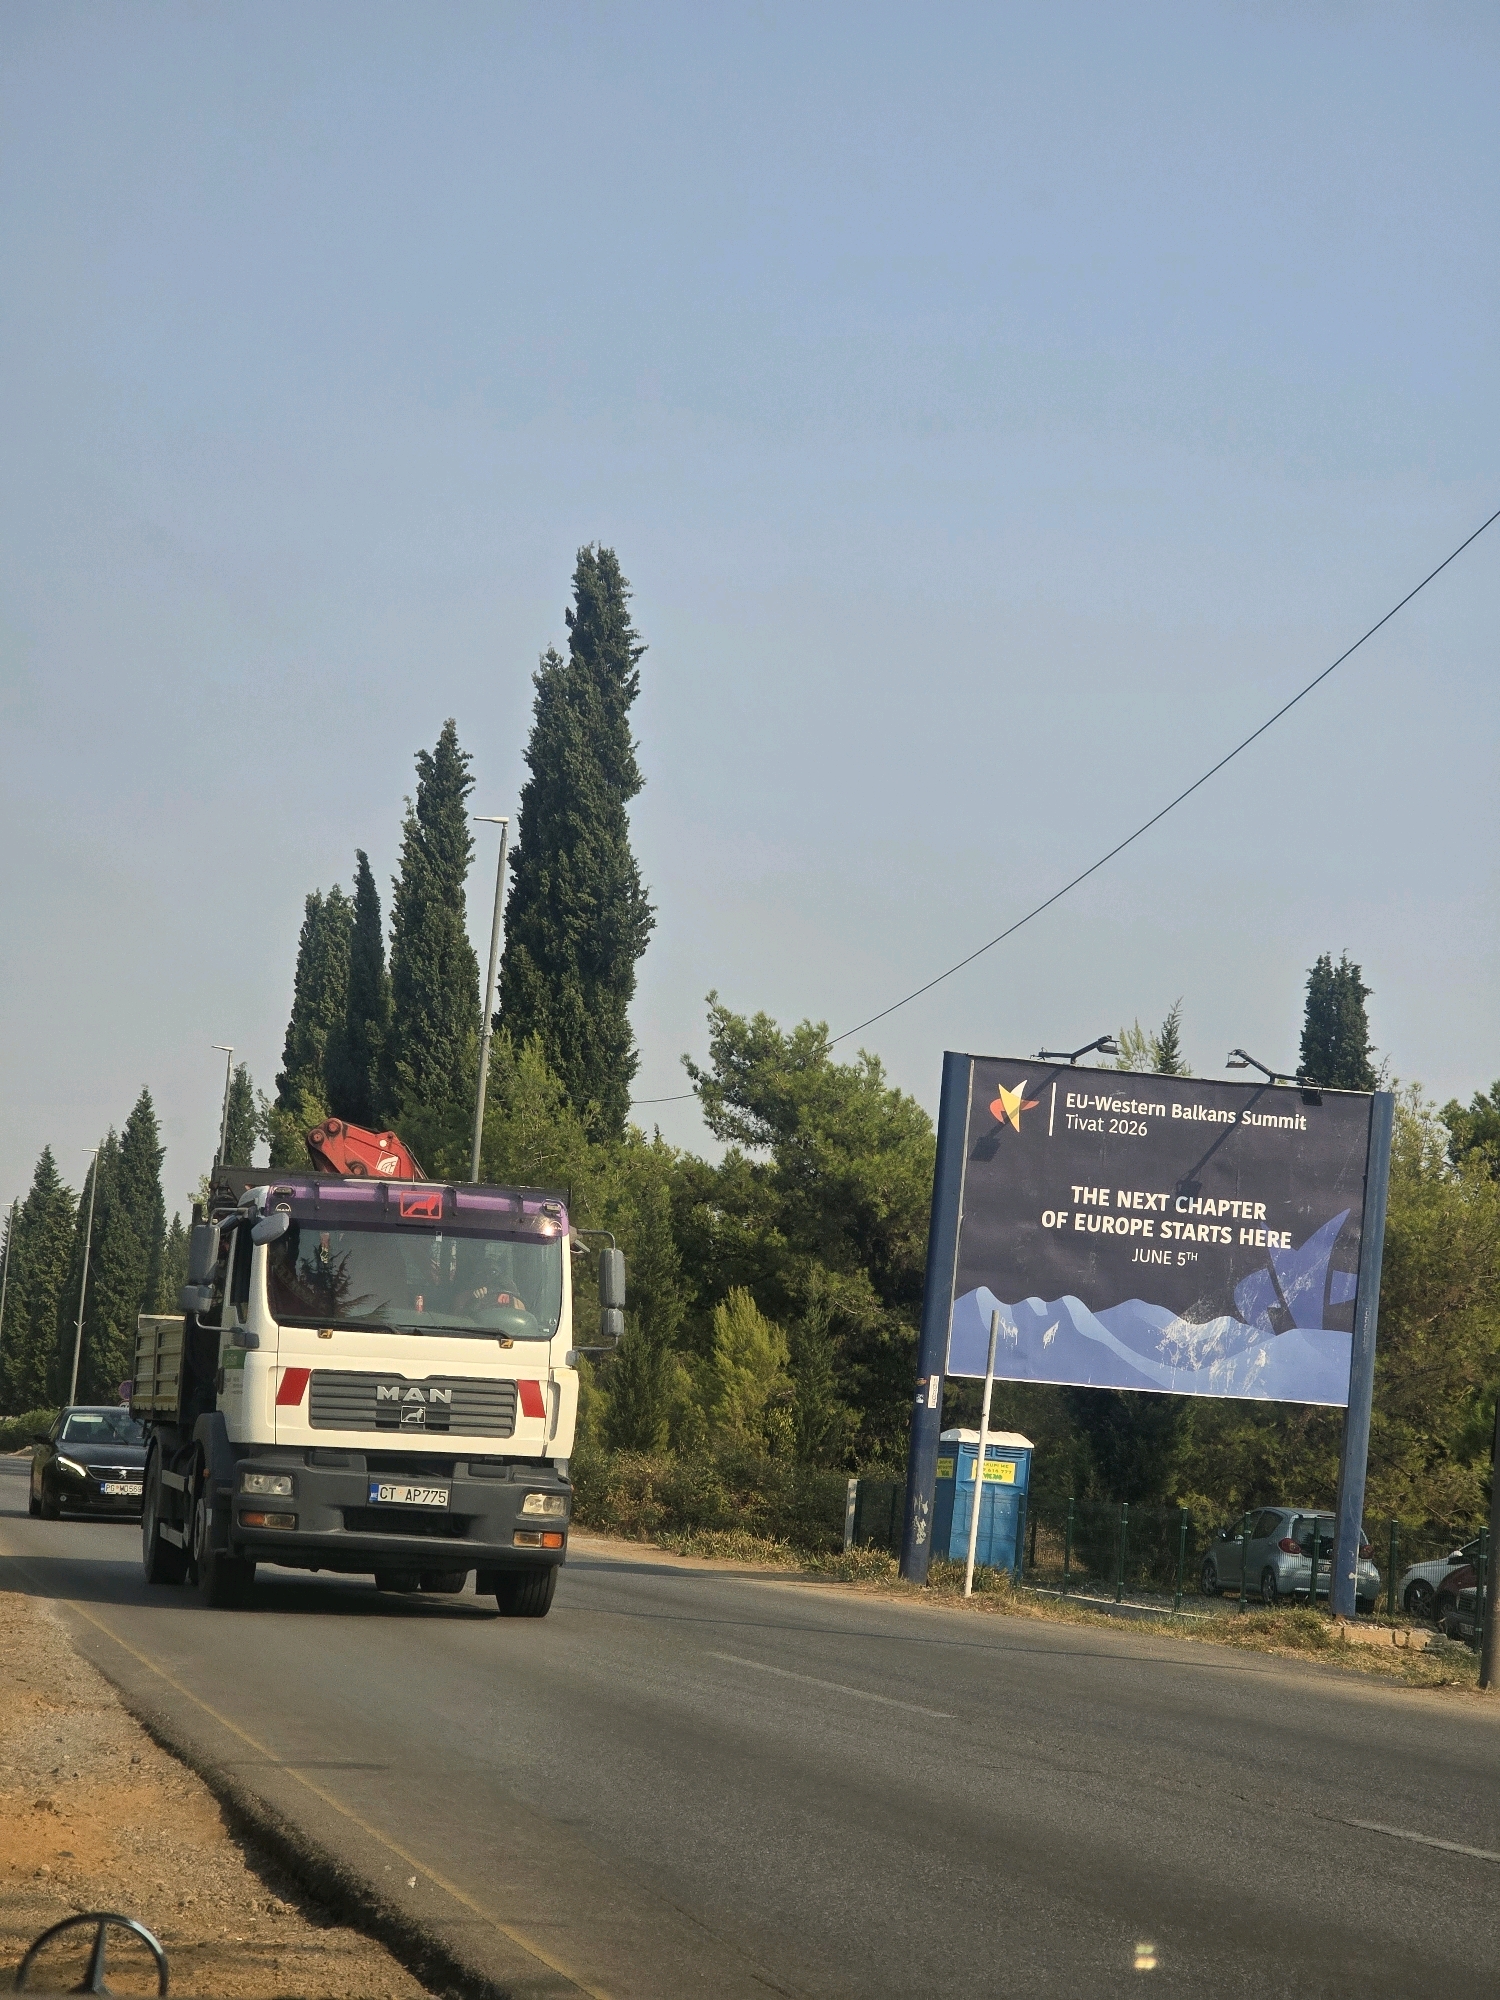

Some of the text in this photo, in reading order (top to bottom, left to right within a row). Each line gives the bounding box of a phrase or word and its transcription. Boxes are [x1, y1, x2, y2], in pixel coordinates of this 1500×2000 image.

[1066, 1092, 1307, 1131] EU-Western Balkans Summit
[1065, 1113, 1148, 1136] Tivat 2026
[1071, 1185, 1267, 1220] THE NEXT CHAPTER
[1041, 1210, 1293, 1249] OF EUROPE STARTS HERE
[1131, 1248, 1199, 1267] JUNE 5TH
[376, 1385, 452, 1404] MAN
[105, 1484, 115, 1492] PG
[380, 1486, 447, 1504] CT AP775
